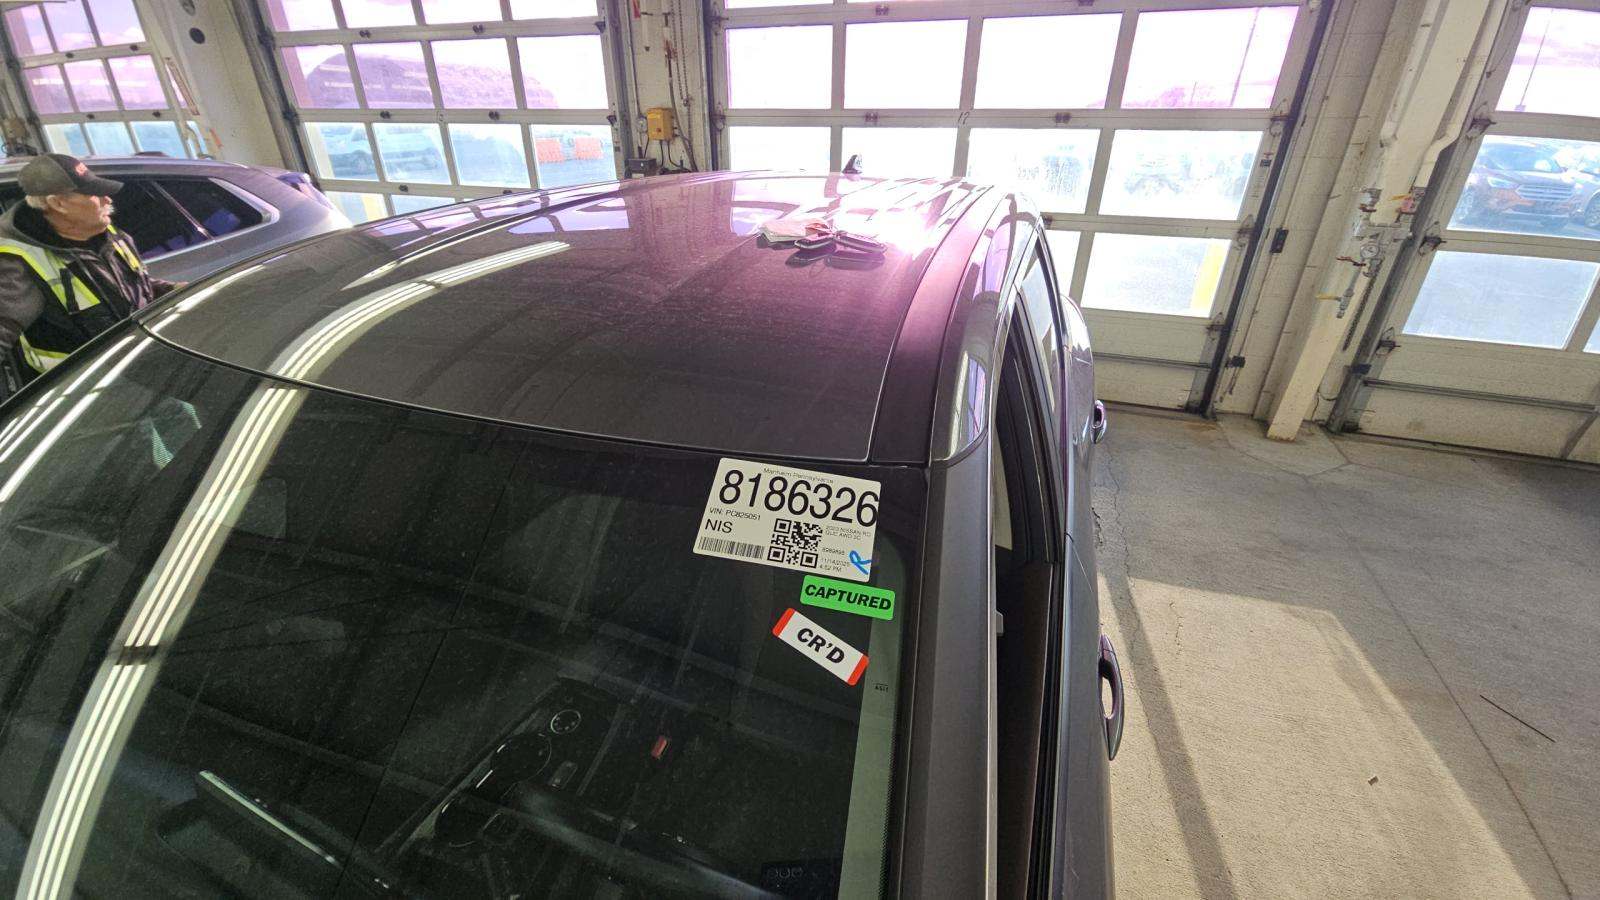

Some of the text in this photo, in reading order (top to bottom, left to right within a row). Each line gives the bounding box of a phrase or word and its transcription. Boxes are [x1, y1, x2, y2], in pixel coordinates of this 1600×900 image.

[719, 469, 878, 527] 8186326
[705, 518, 733, 534] NIS
[805, 585, 891, 611] CAPTURED
[798, 628, 845, 664] CR'D
